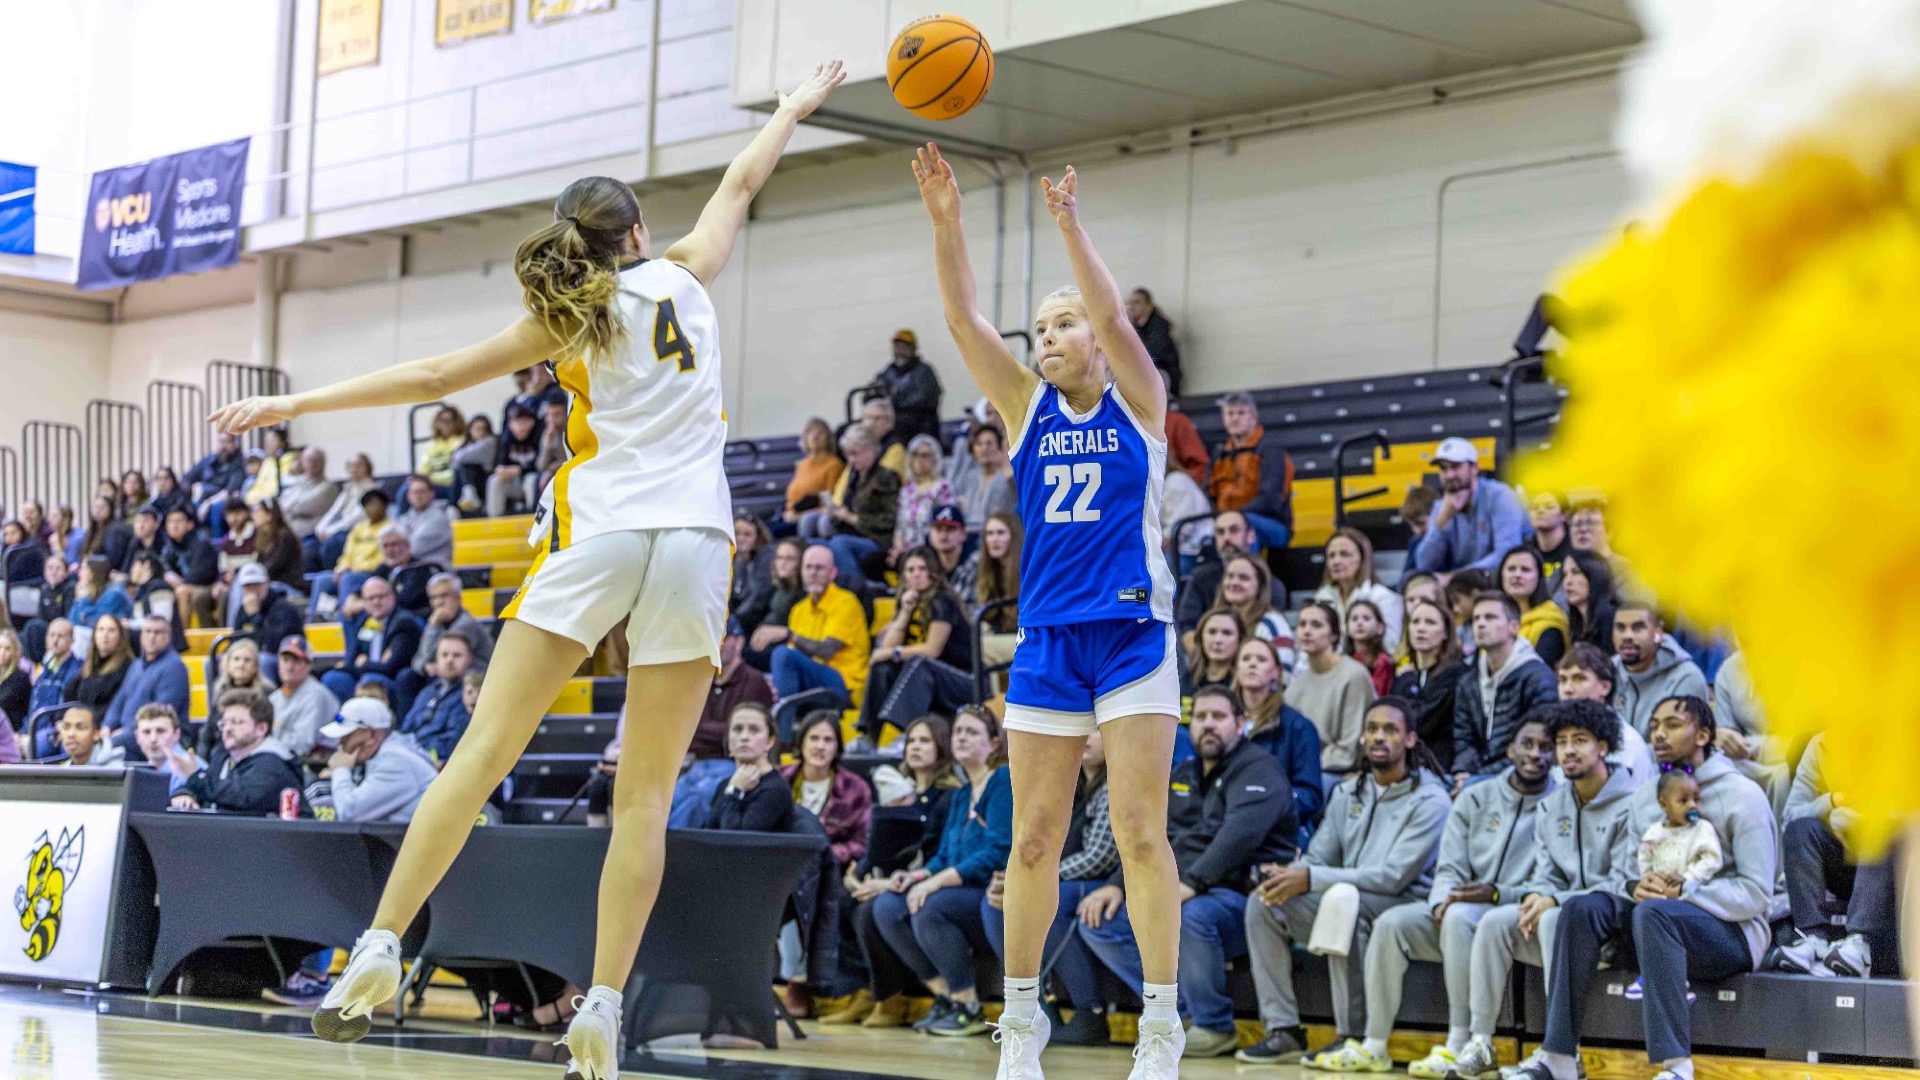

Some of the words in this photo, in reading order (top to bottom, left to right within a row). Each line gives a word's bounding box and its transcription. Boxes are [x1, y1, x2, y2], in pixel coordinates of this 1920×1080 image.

[110, 191, 152, 228] VCU
[652, 296, 698, 373] 4
[1044, 462, 1102, 523] 22
